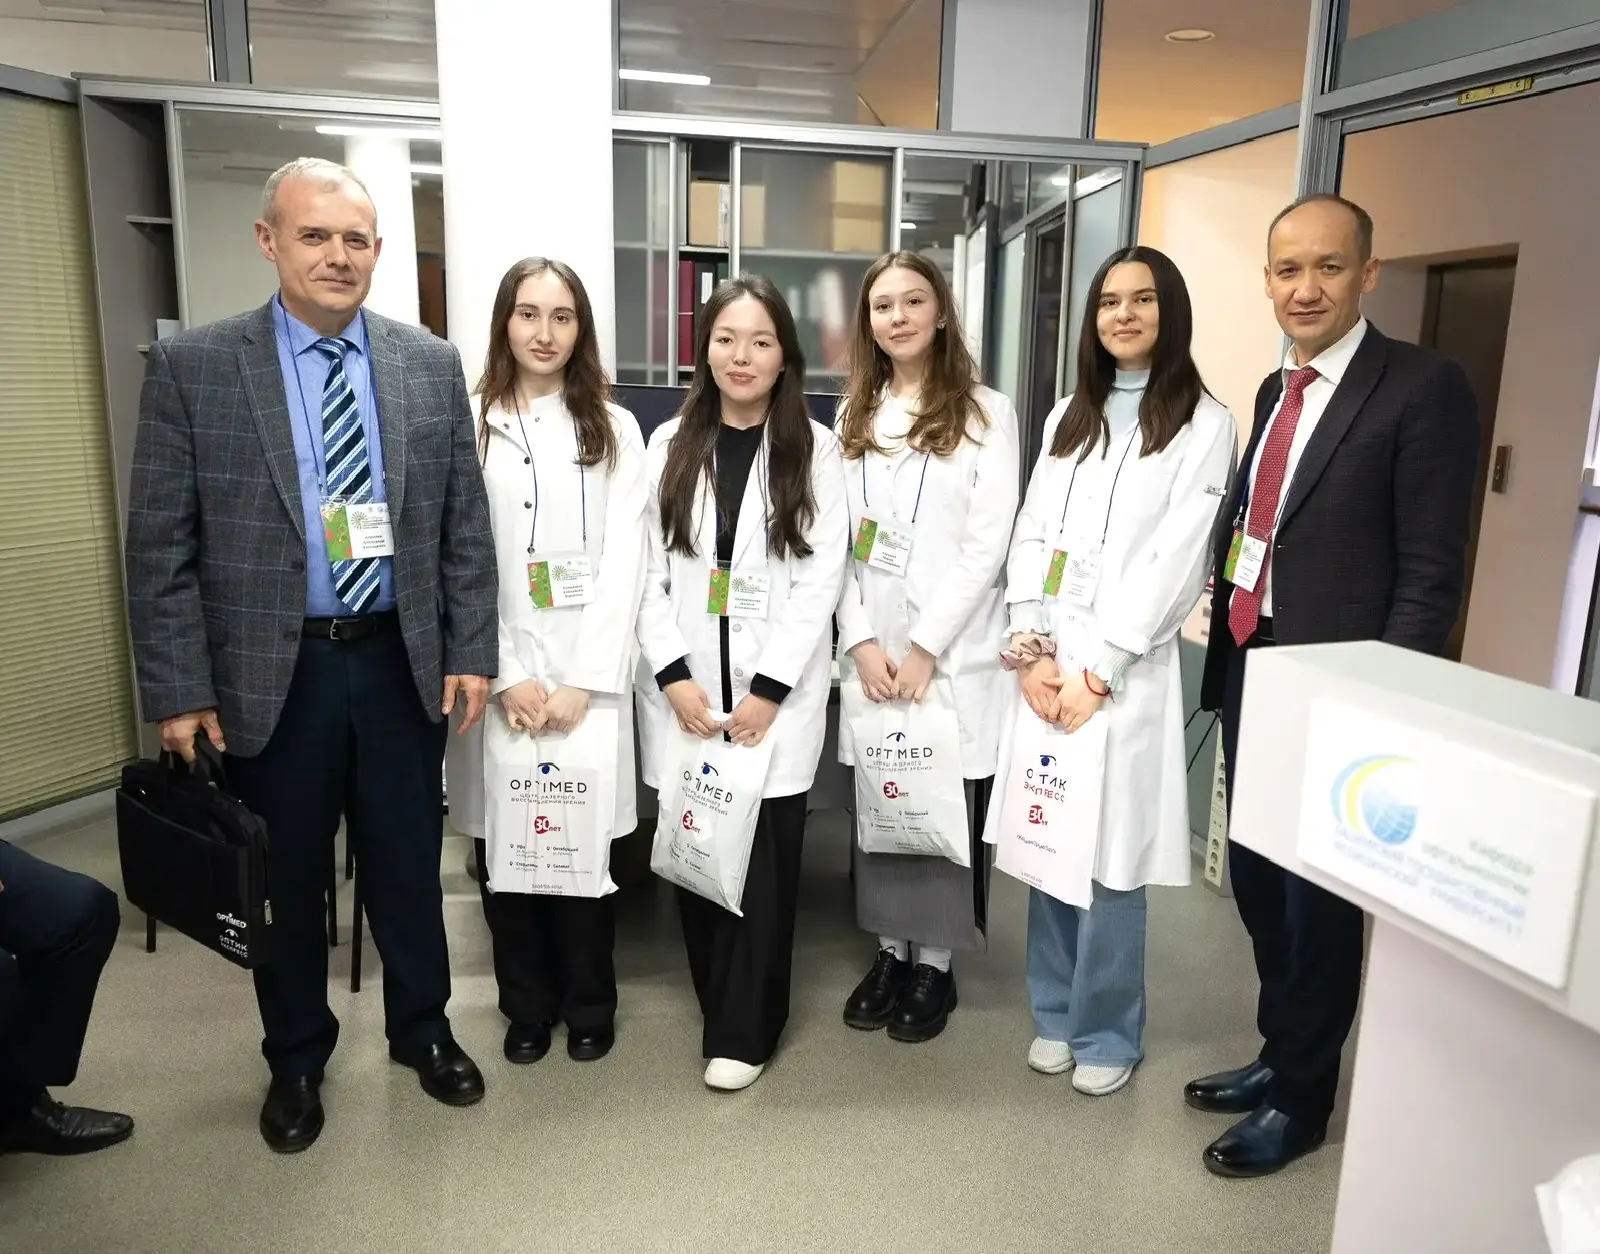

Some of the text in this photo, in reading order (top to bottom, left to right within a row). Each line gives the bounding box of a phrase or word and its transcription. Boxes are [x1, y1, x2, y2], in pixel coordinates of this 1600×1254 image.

[884, 782, 899, 798] 30
[1029, 806, 1043, 823] 30
[534, 817, 550, 833] 30
[216, 912, 247, 929] OPTIMED
